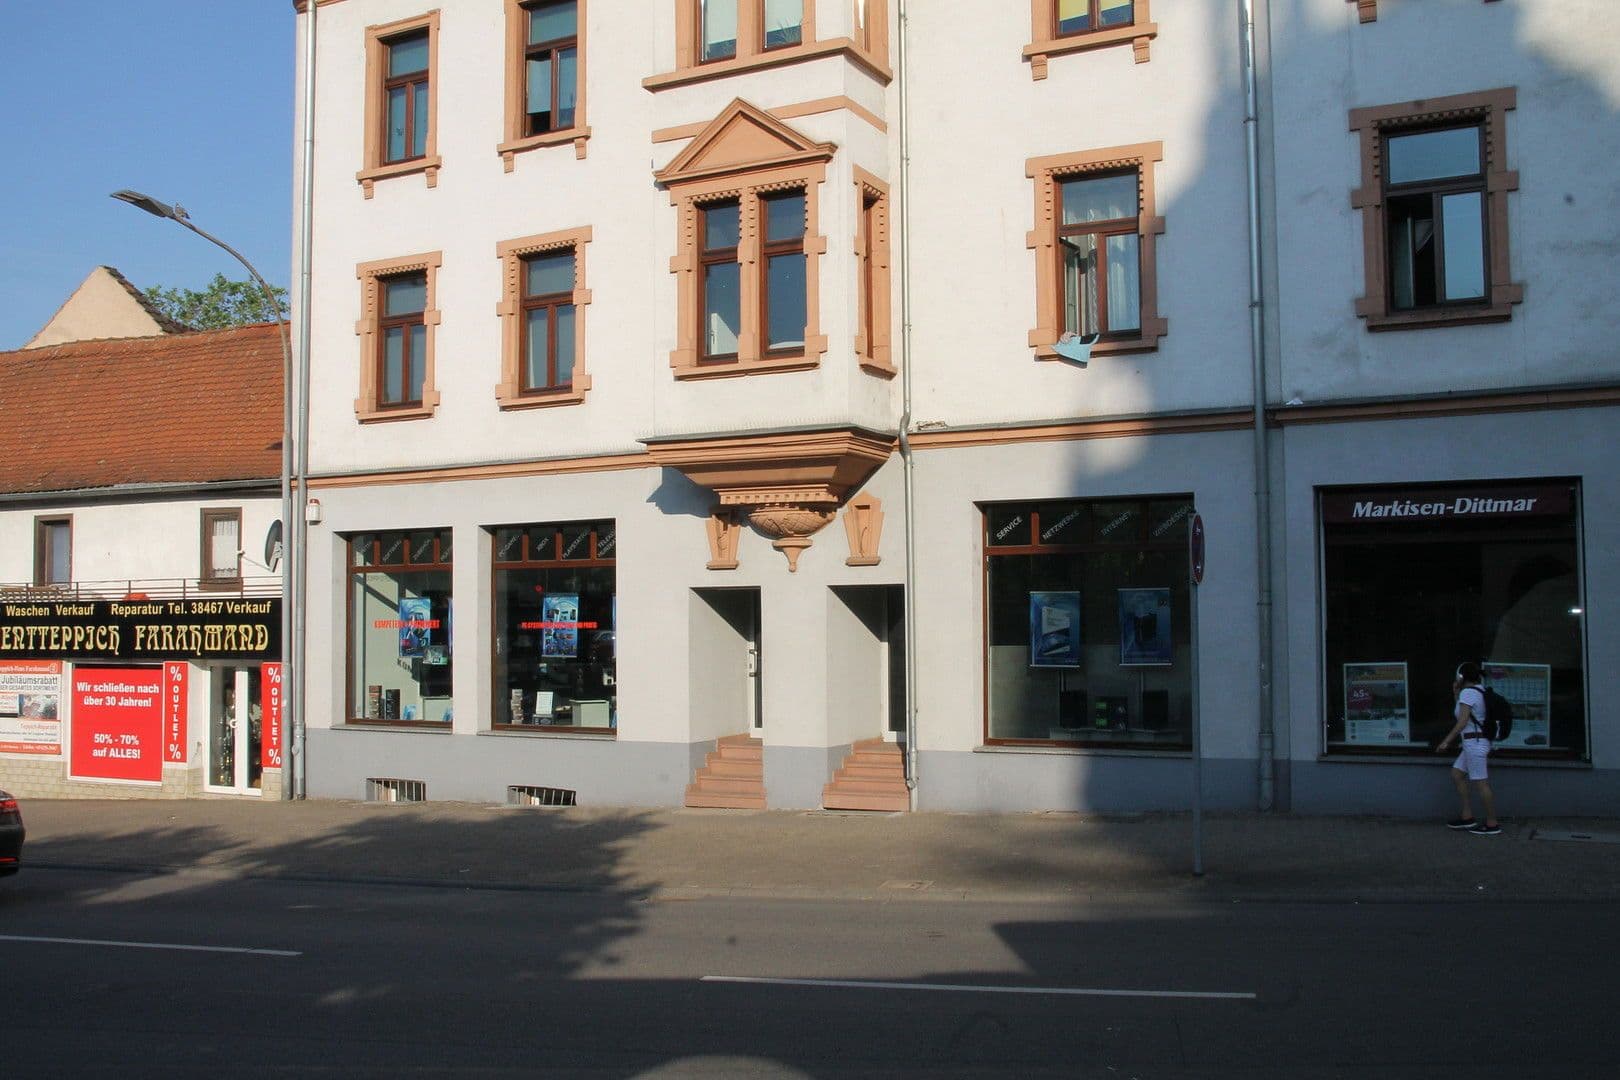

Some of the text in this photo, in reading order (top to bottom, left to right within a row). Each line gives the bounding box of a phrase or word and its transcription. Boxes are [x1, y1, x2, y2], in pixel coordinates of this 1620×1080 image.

[1352, 497, 1537, 518] Markisen-Dittmar
[996, 515, 1023, 540] SERVICE
[6, 601, 272, 617] Waschen Verkauf Reparatur Tel. 38467 Verkauf
[134, 624, 269, 656] FARAHMAND
[76, 682, 159, 694] Wir schließen nach
[84, 696, 152, 707] über 30 Jahren!
[169, 666, 183, 760] % OUTLET %
[267, 667, 281, 765] % OUTLET %
[94, 733, 112, 744] 50%
[120, 735, 140, 746] 70%
[92, 747, 141, 759] auf ALLES!
